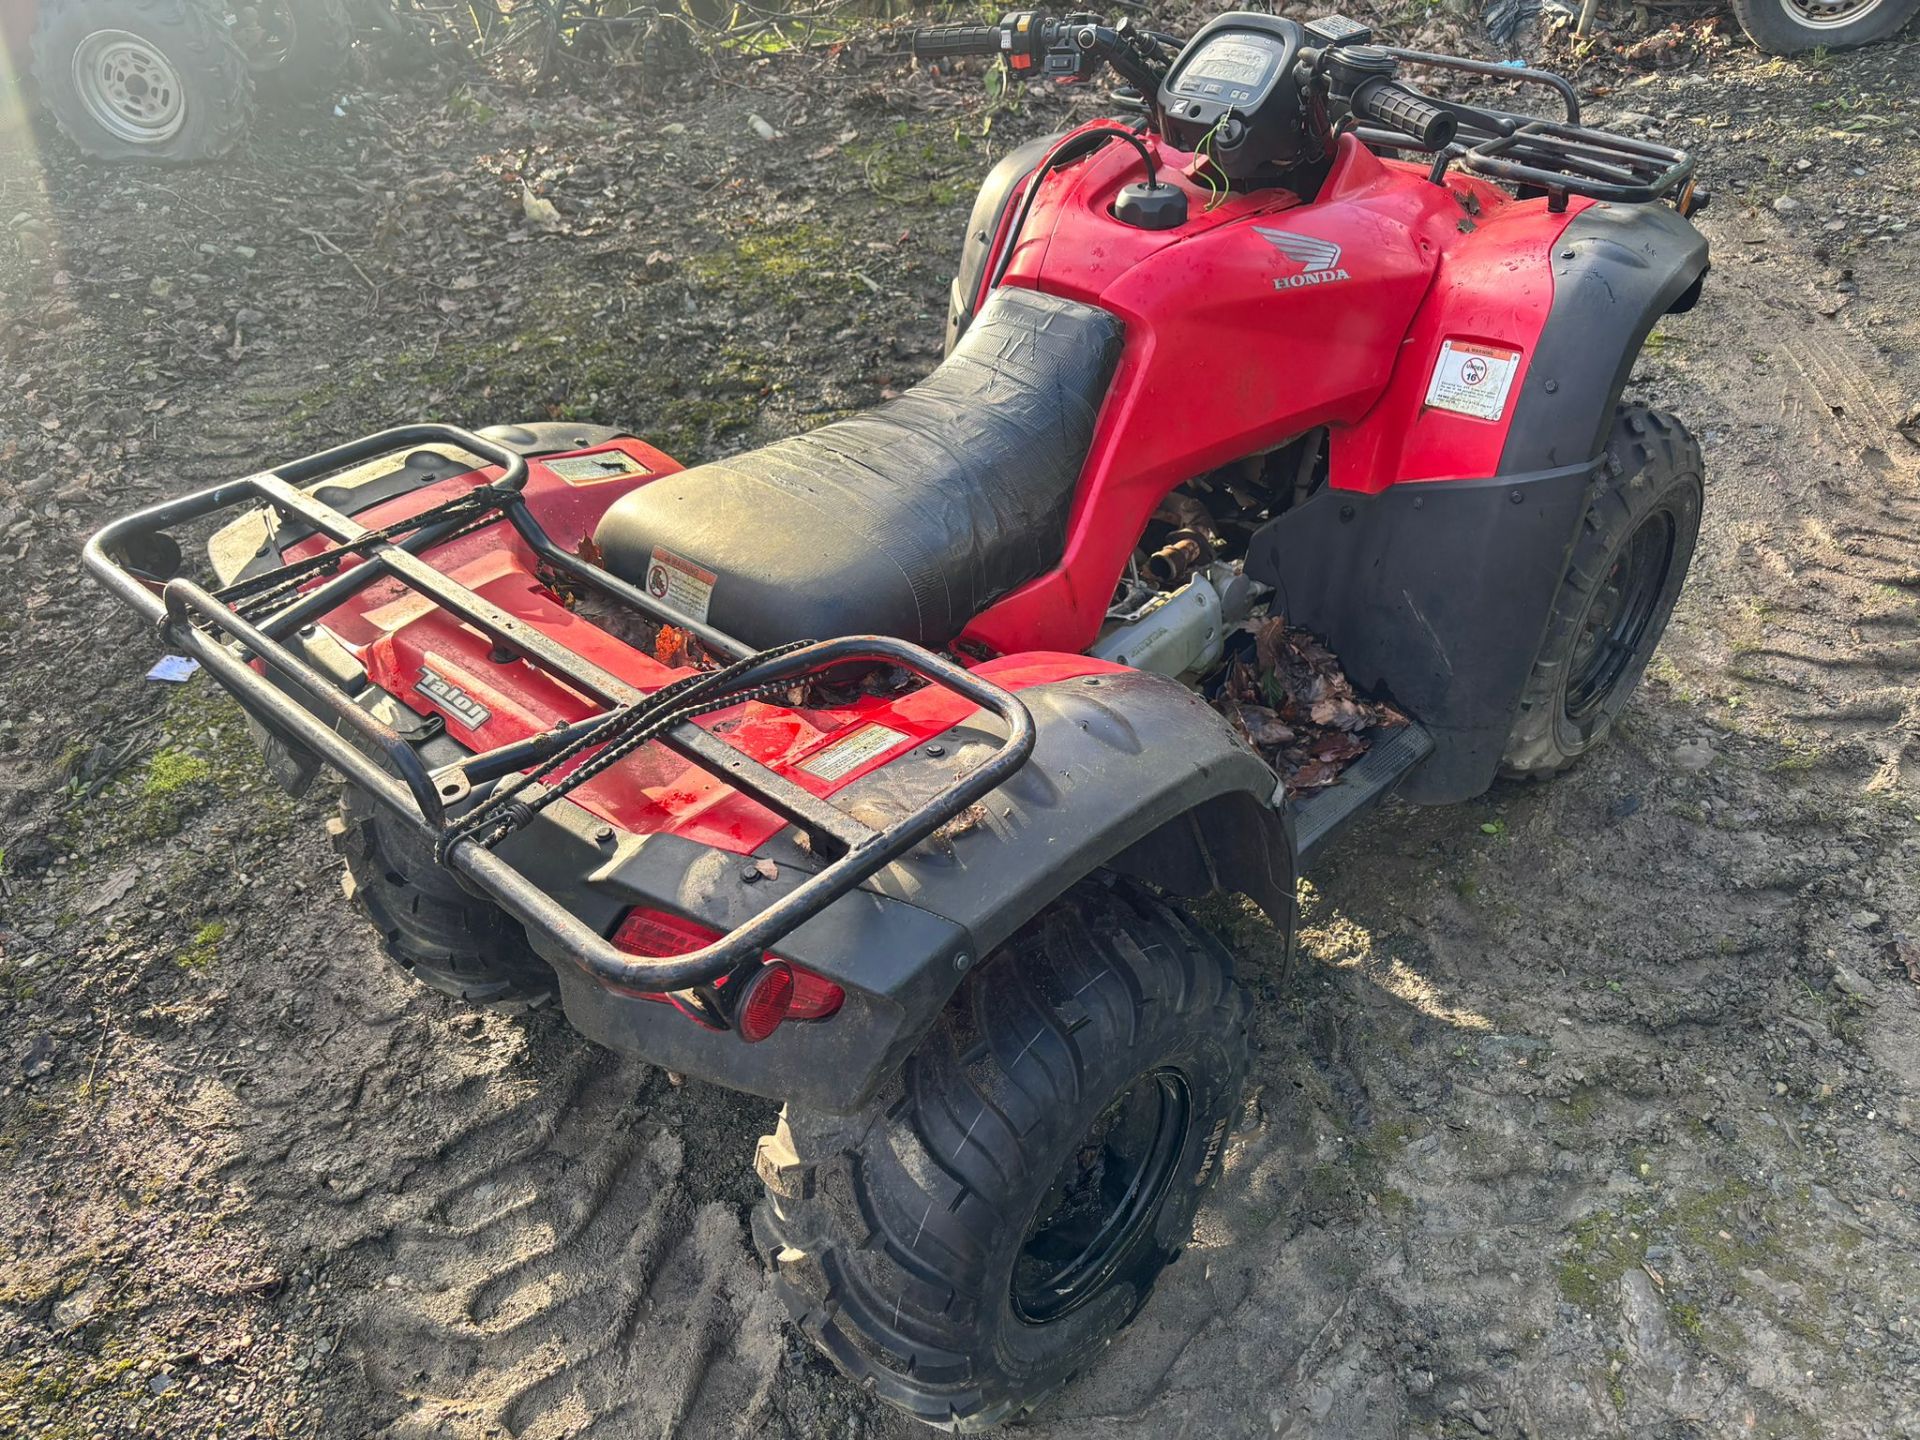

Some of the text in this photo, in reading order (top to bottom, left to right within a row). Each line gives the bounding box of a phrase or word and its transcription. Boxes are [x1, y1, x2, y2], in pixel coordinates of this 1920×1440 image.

[1273, 268, 1350, 290] HONDA
[1466, 363, 1484, 372] UNDER
[1466, 373, 1477, 382] 16
[418, 666, 490, 726] Talon
